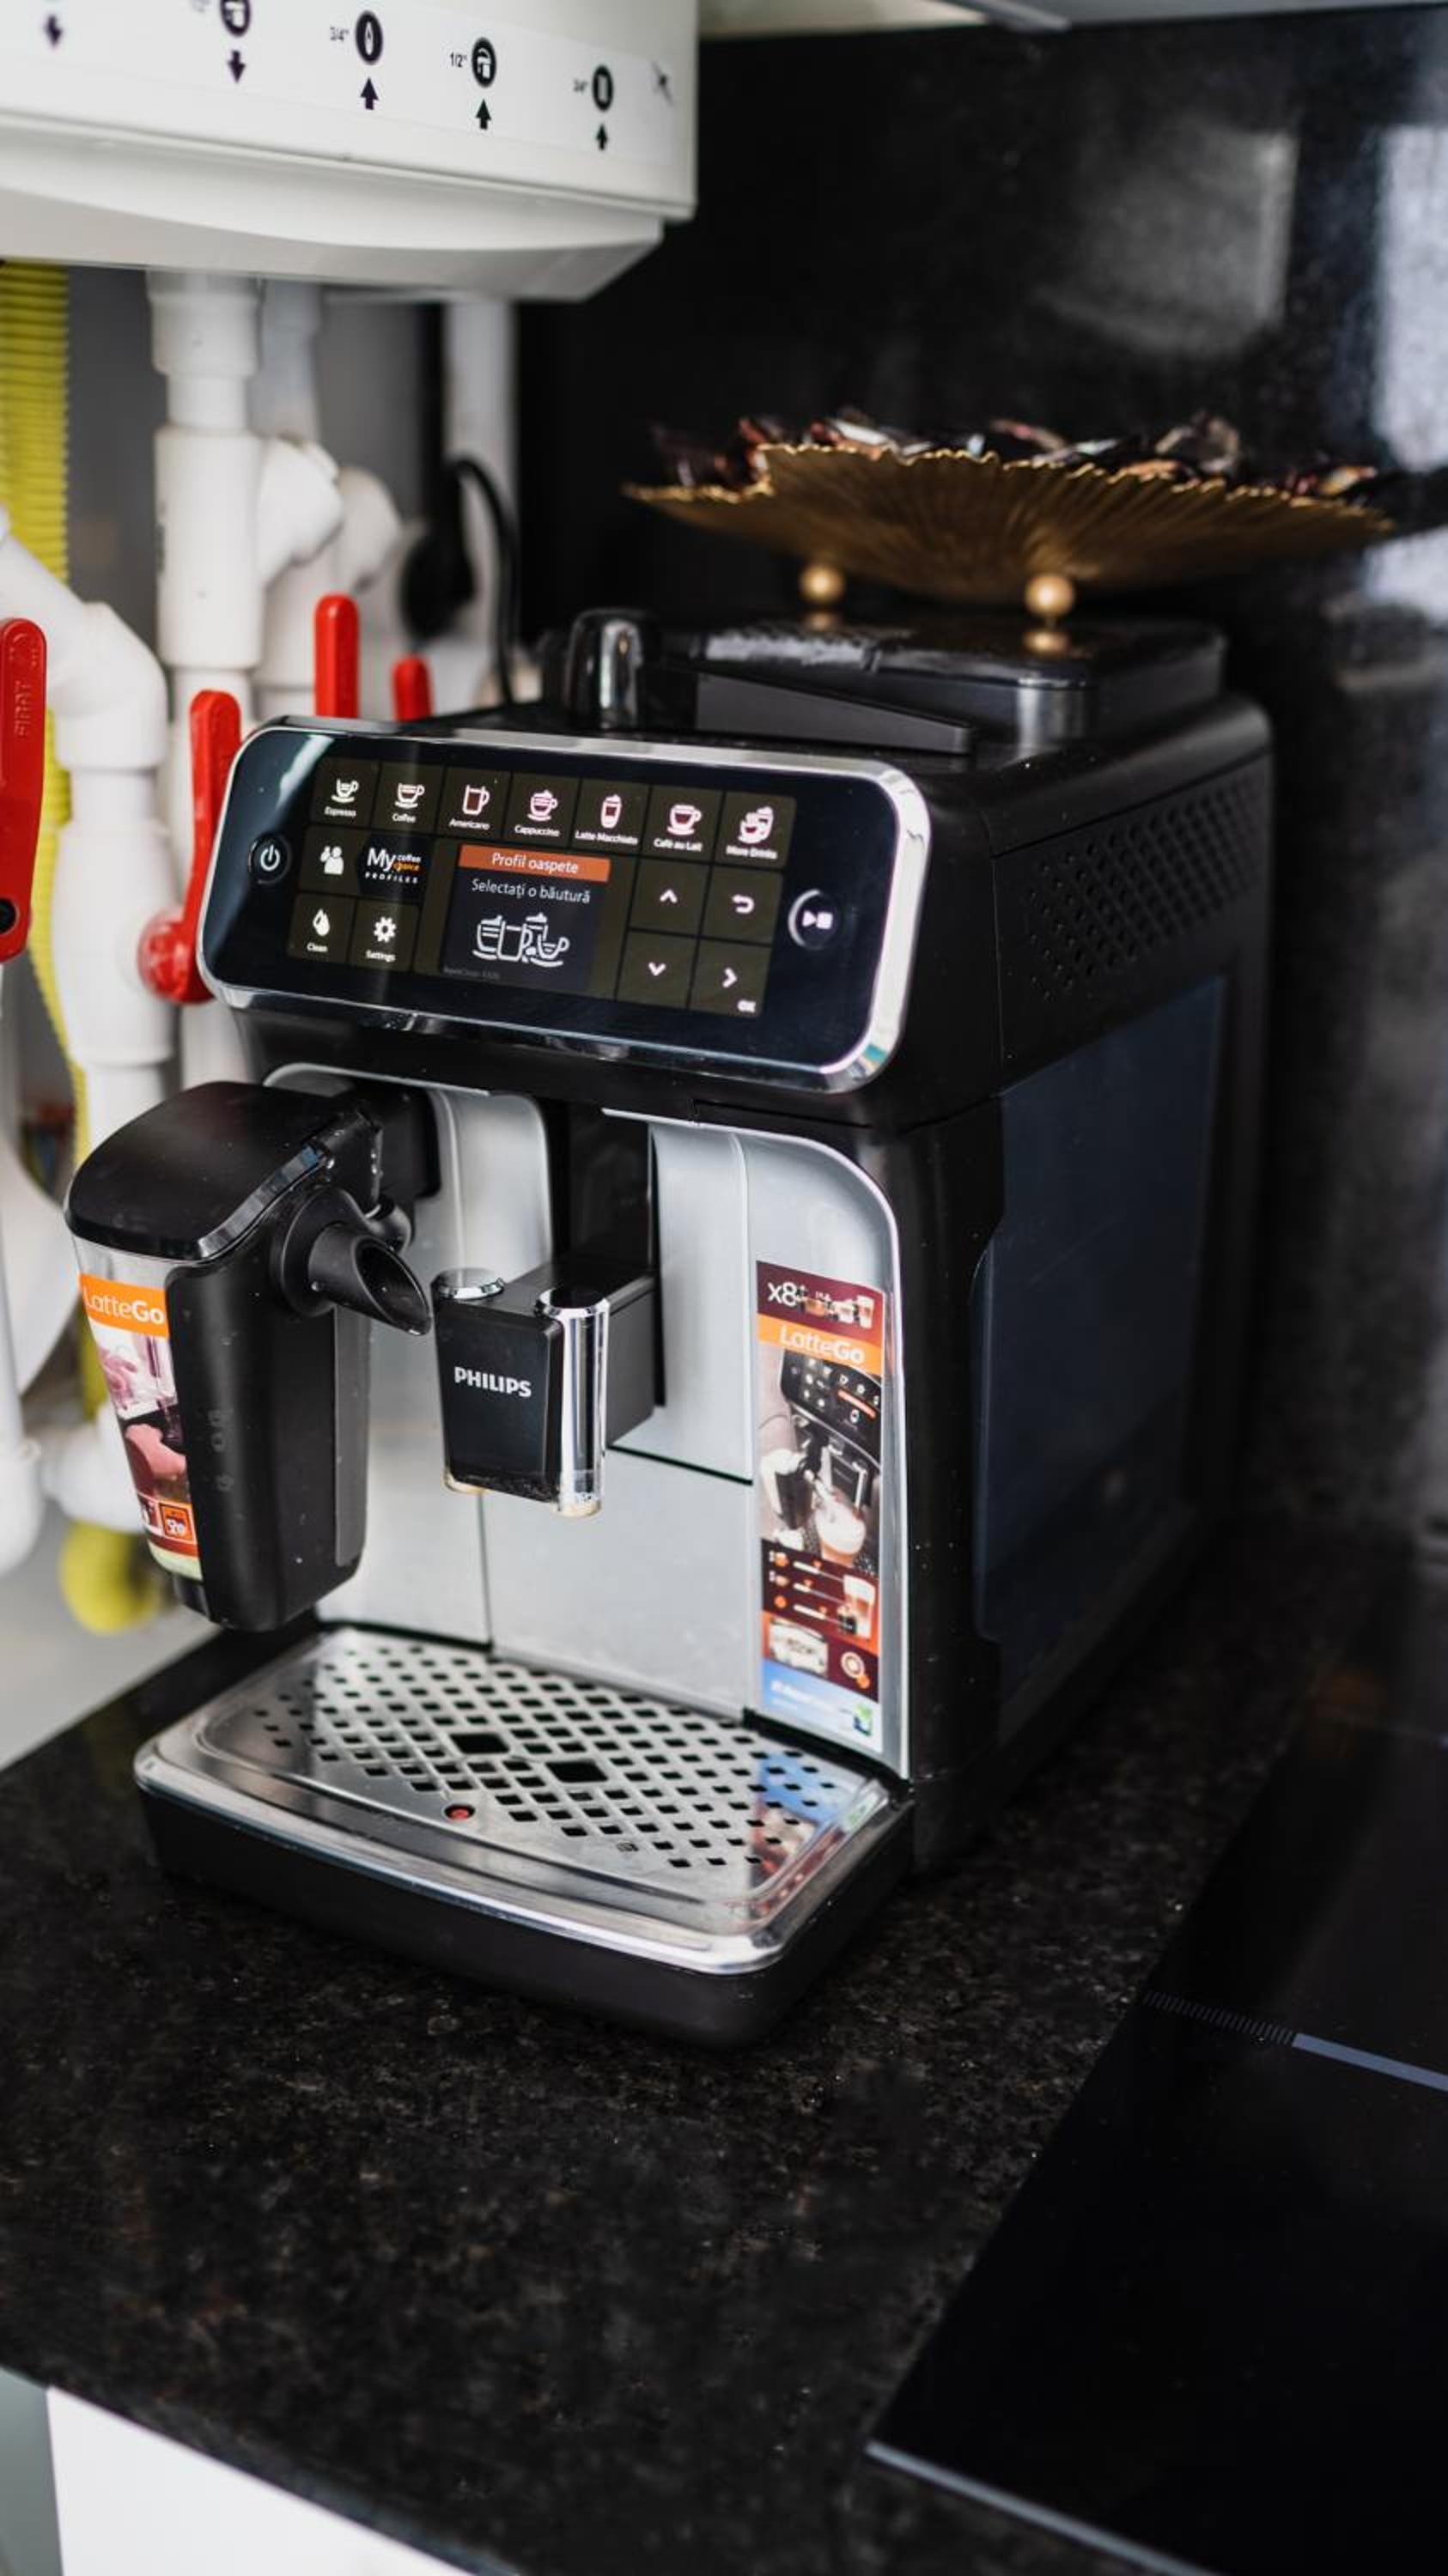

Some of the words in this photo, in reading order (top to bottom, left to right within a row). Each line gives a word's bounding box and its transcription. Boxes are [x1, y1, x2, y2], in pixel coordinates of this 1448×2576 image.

[324, 806, 356, 817] Espresso
[392, 813, 417, 823] Coffee
[449, 818, 490, 830] Americano
[514, 825, 560, 837] Cappuccino
[575, 830, 595, 841] Latte
[597, 833, 639, 845] Macchiato
[673, 841, 685, 851] au
[686, 841, 703, 852] Lait
[727, 846, 748, 857] More
[367, 848, 397, 872] My
[491, 852, 527, 867] Profil
[528, 858, 579, 874] oaspete
[365, 872, 419, 884] PROFILES
[528, 888, 537, 898] o
[737, 999, 757, 1013] OK
[780, 1324, 866, 1364] LatteGo
[454, 1366, 532, 1398] PHILIPS
